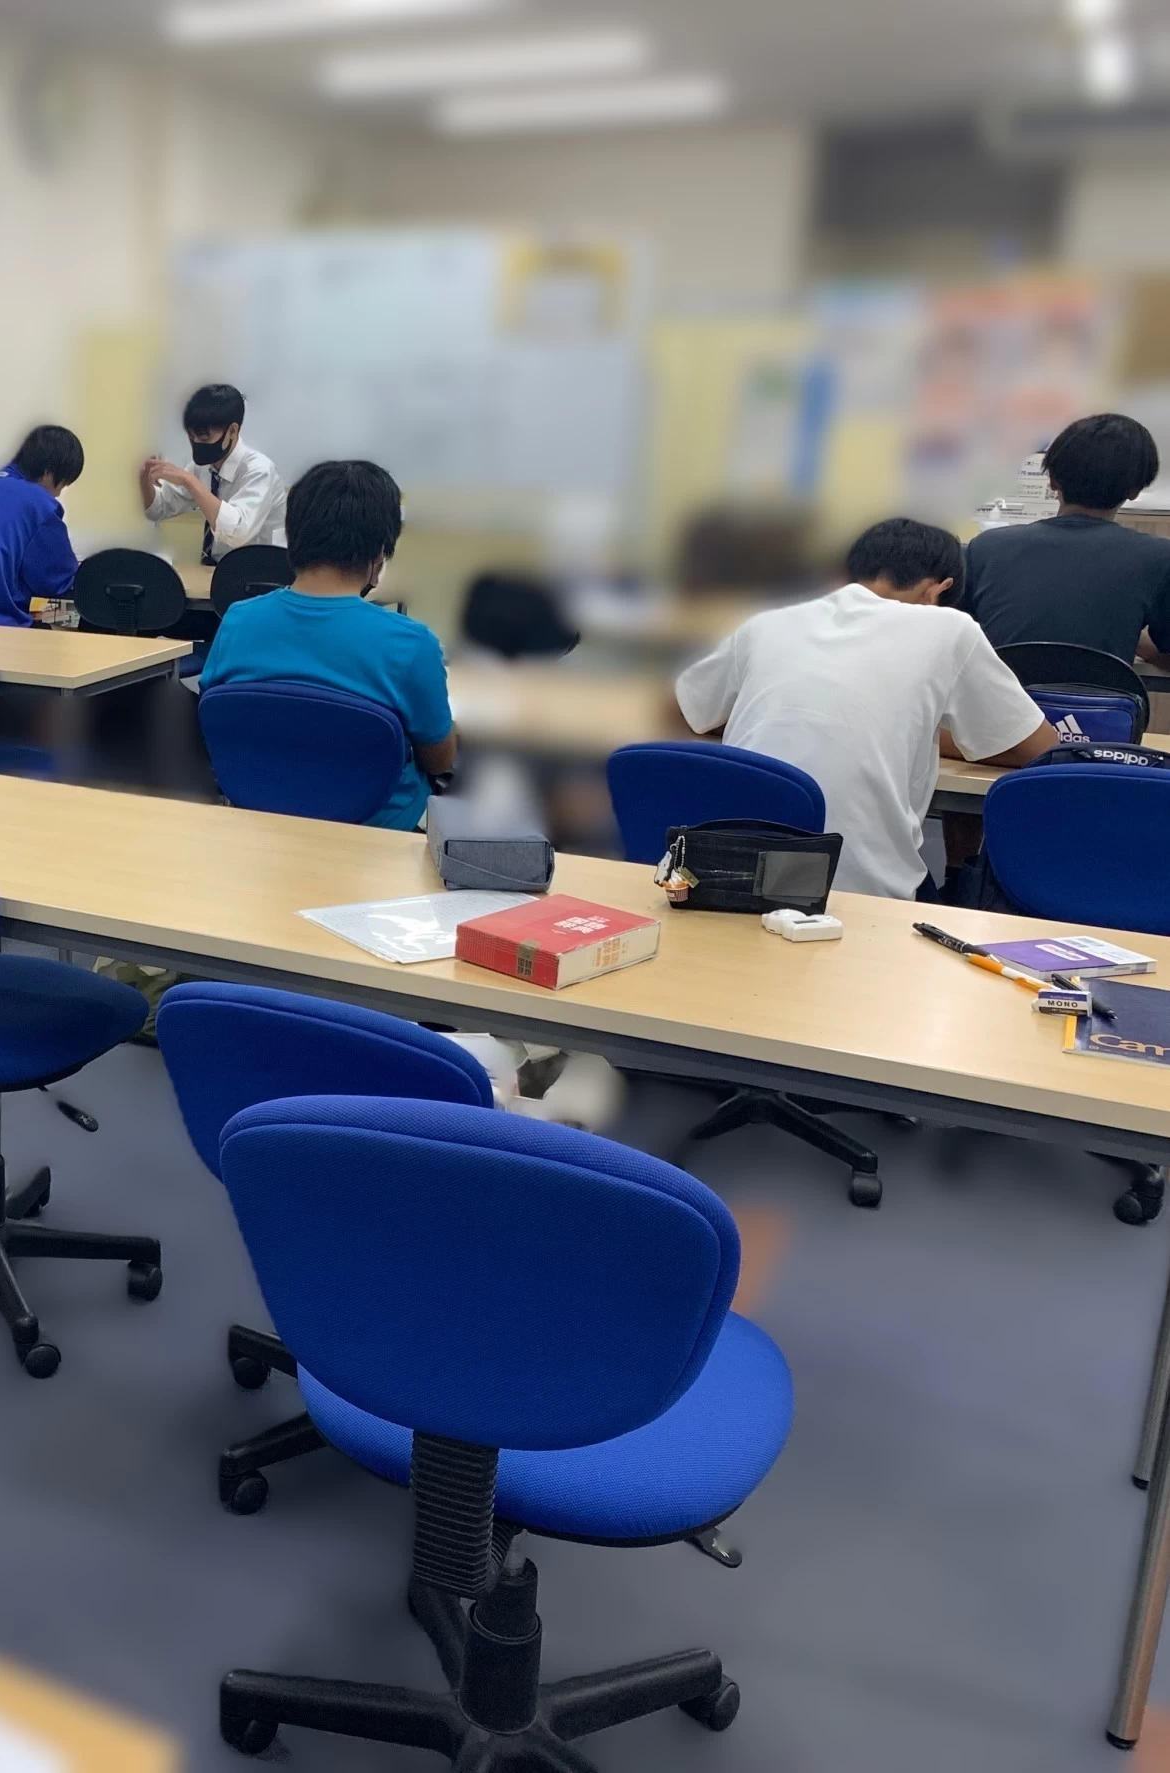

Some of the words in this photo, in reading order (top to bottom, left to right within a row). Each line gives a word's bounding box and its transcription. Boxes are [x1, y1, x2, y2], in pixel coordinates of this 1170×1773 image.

[1057, 731, 1091, 743] idas
[1093, 749, 1149, 766] adidas
[1047, 1000, 1078, 1008] MONO
